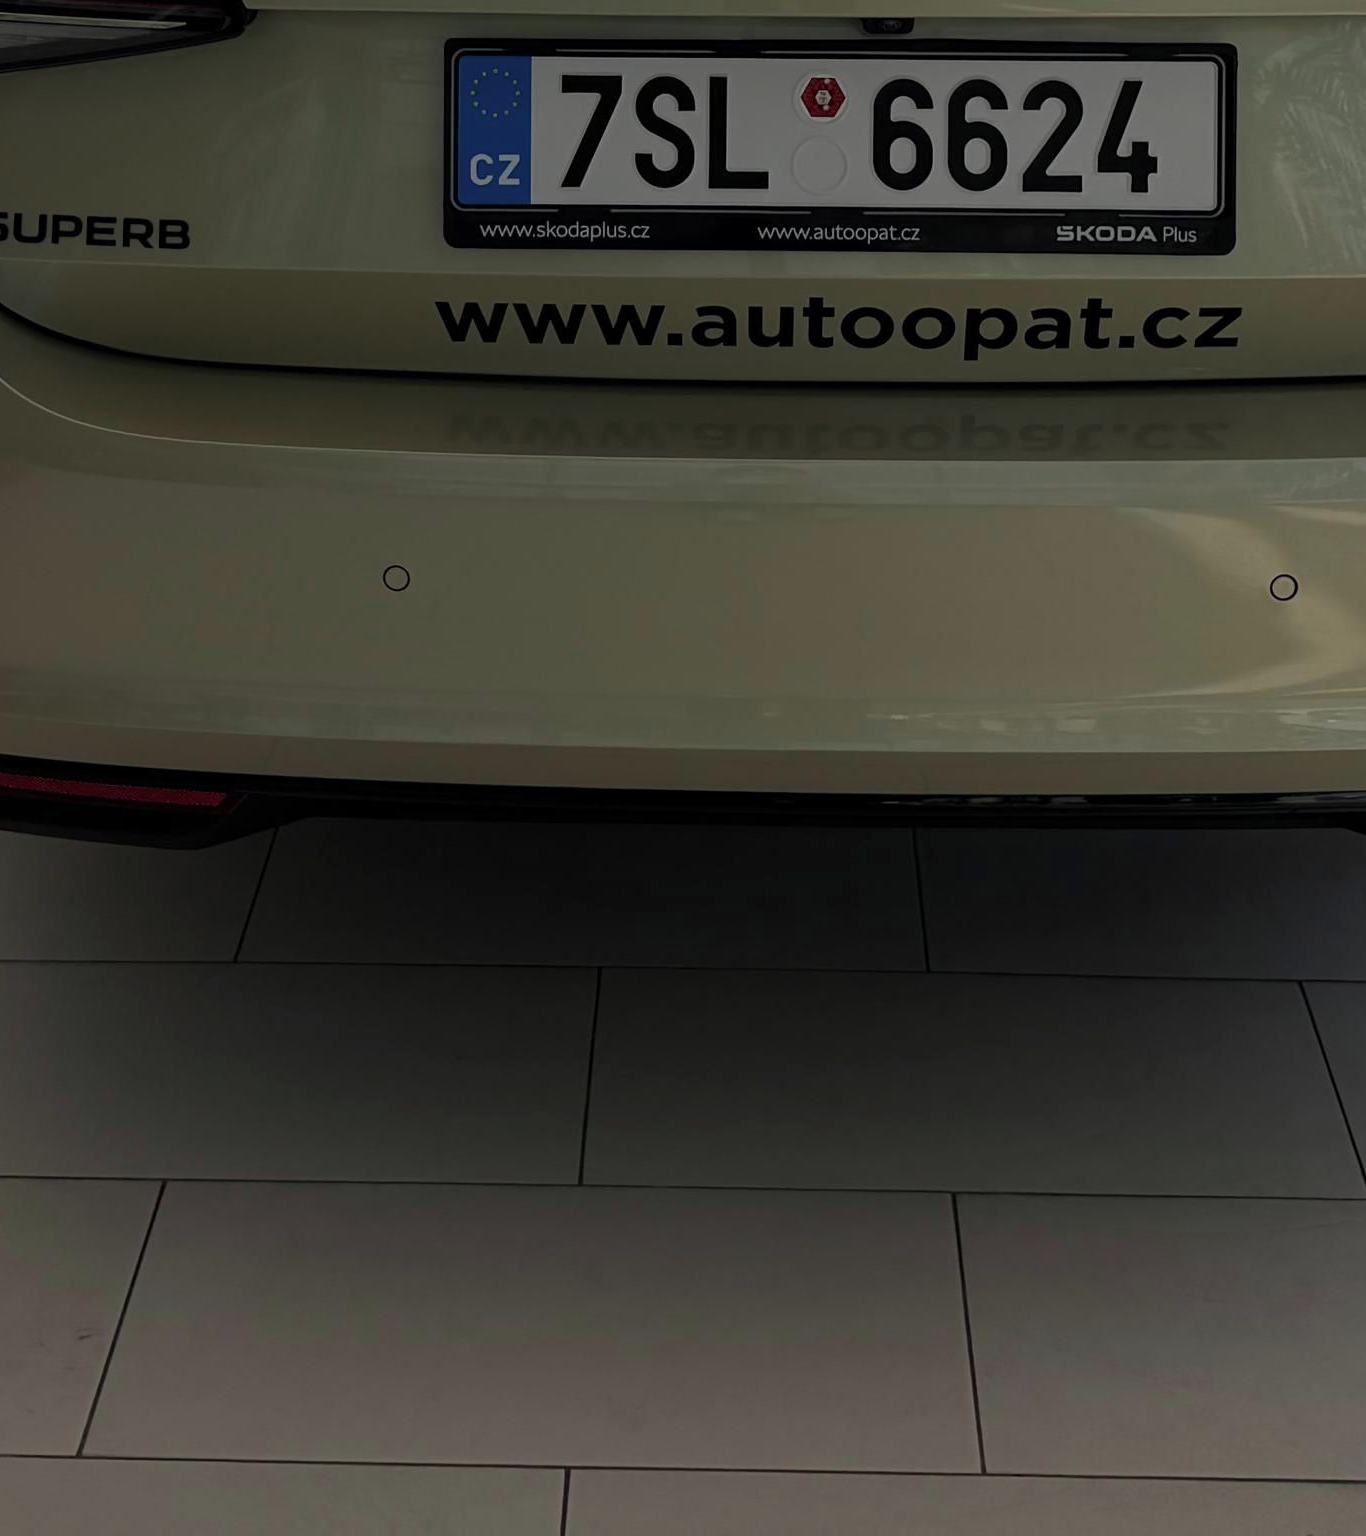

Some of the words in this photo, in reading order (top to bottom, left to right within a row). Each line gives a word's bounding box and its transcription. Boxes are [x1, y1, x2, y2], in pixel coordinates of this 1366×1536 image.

[560, 74, 770, 190] 7SL
[871, 77, 1159, 194] 6624
[469, 152, 521, 187] CZ
[479, 220, 650, 243] www.skodaplus.cz
[756, 224, 921, 245] www.autoopat.cz
[1056, 224, 1157, 243] SKODA
[1162, 225, 1198, 244] Plus
[434, 296, 1245, 362] www.autoopat.cz
